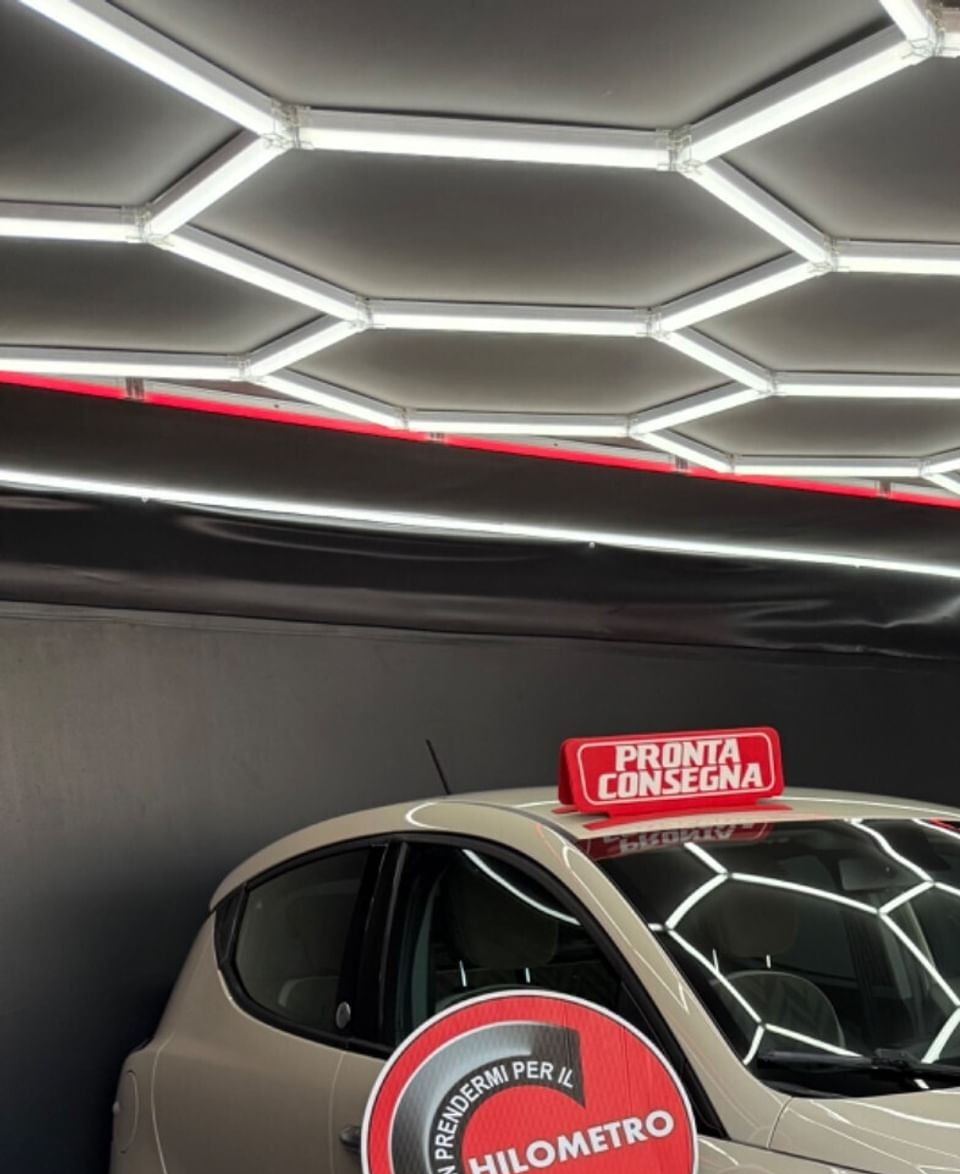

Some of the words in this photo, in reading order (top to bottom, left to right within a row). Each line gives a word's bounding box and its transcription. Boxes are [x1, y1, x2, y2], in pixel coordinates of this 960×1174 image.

[614, 738, 741, 772] PRONTA
[598, 763, 764, 800] CONSEGNA
[434, 1064, 510, 1160] PRENDERMI
[513, 1060, 554, 1082] PER
[557, 1066, 575, 1088] IL
